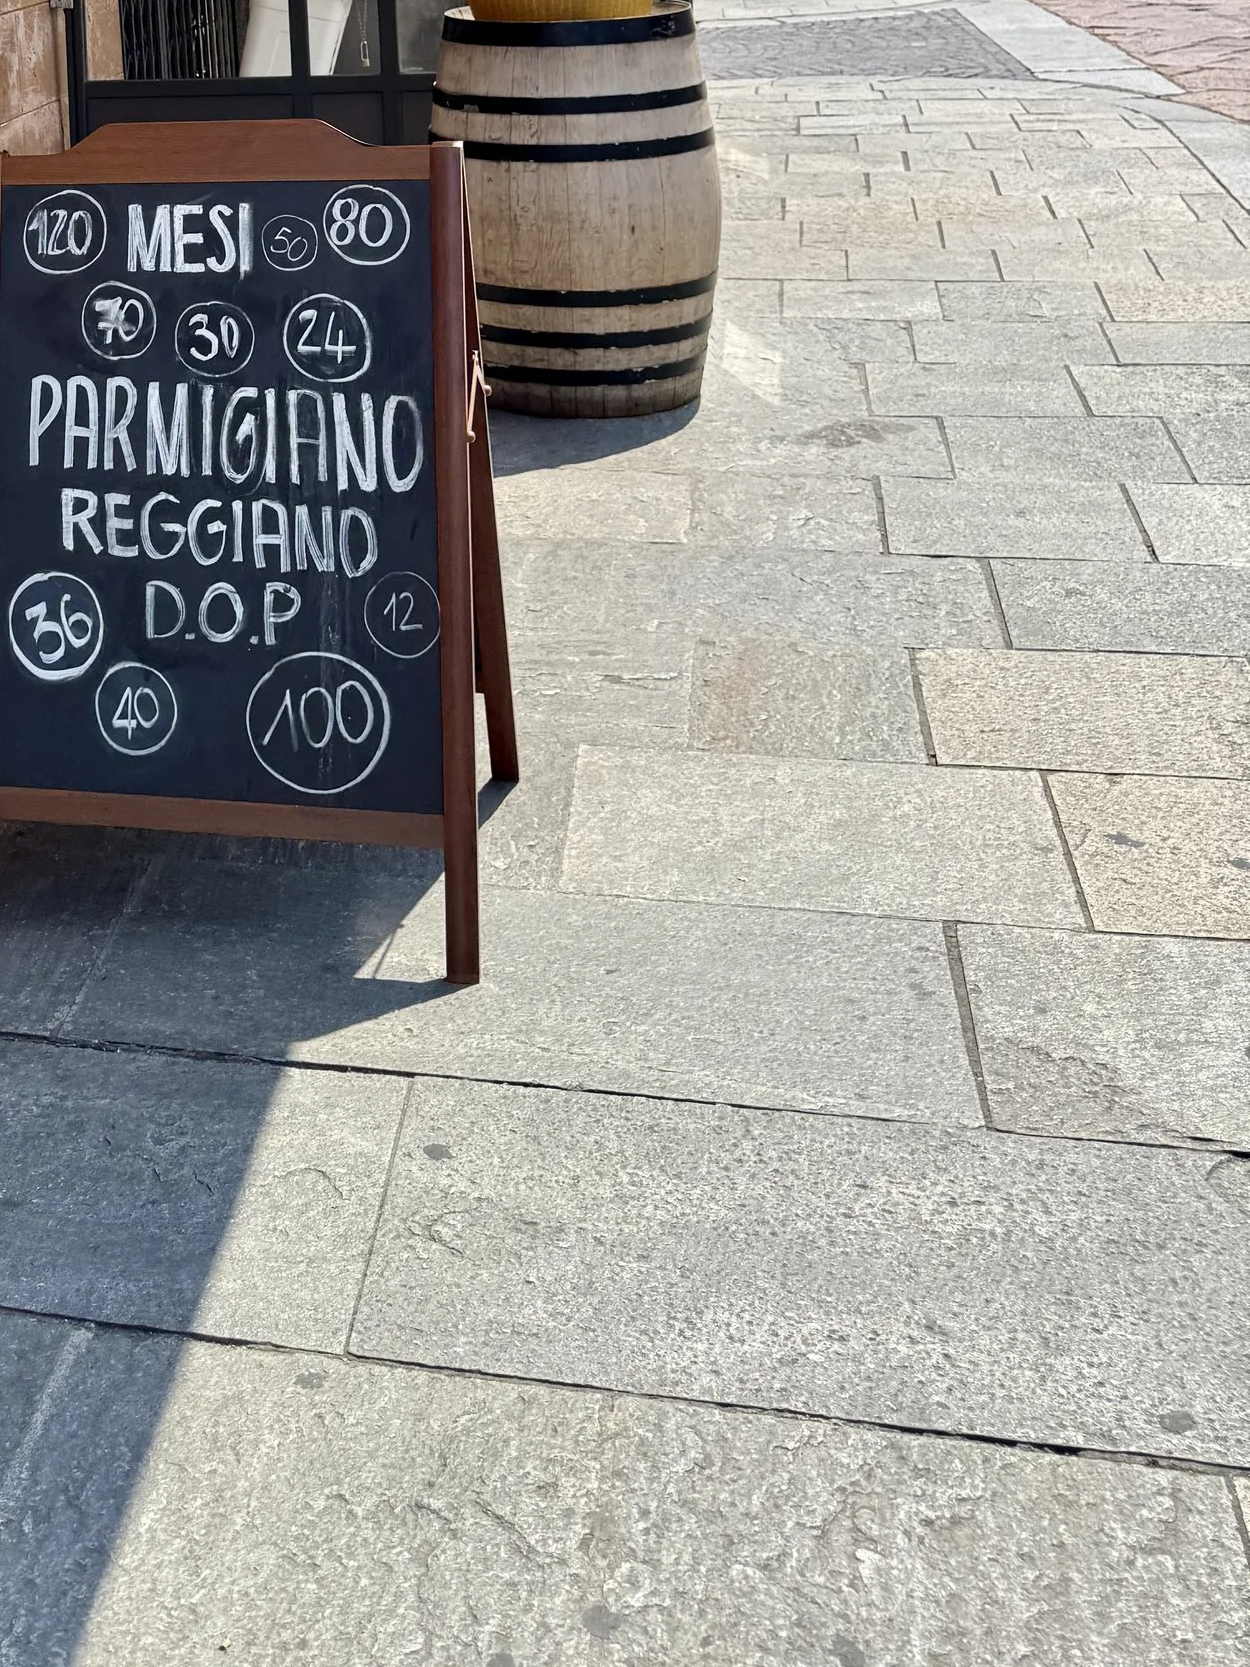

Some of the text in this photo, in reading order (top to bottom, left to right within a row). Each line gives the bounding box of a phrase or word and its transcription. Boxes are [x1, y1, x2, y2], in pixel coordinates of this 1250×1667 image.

[28, 208, 92, 256] 120
[127, 202, 253, 279] MESI
[269, 227, 308, 262] 50
[329, 198, 393, 248] 80
[188, 312, 240, 362] 30
[296, 309, 357, 364] 24
[28, 375, 424, 494] PARMIGIANO
[61, 488, 378, 578] REGGIANO
[25, 593, 94, 664] 36
[382, 591, 424, 632] 12
[111, 685, 159, 740] 40
[262, 679, 374, 752] 100
